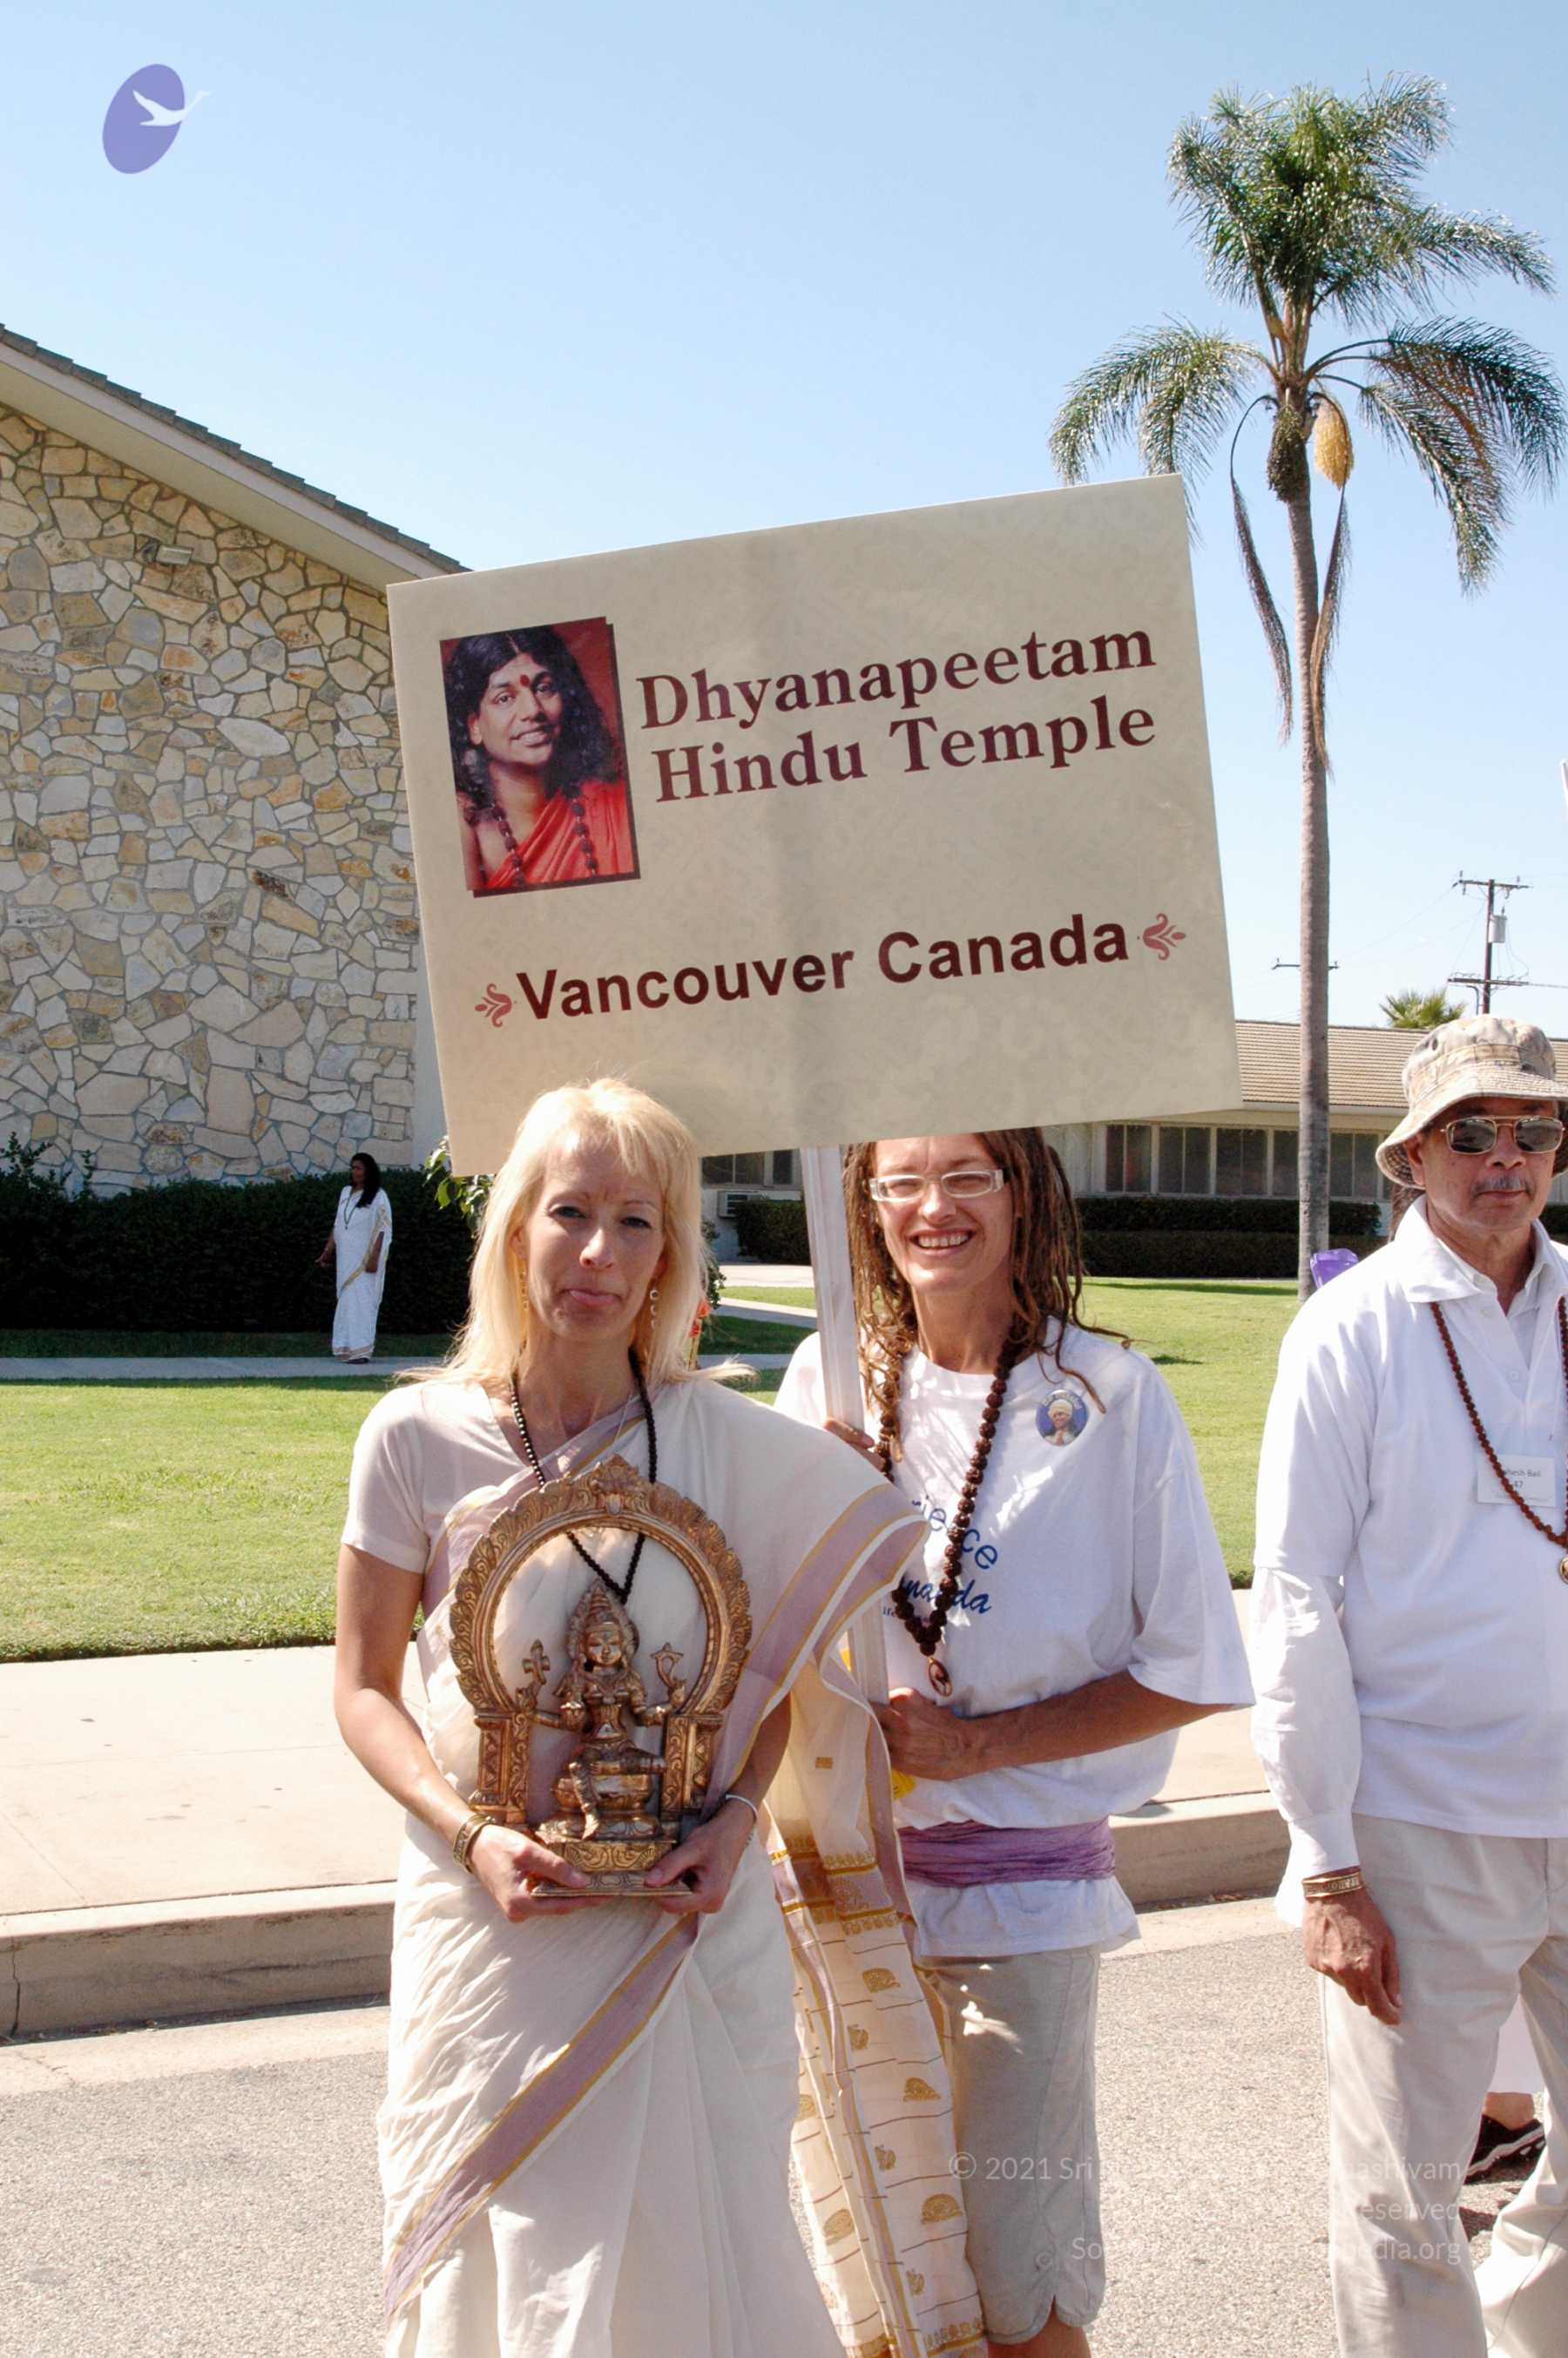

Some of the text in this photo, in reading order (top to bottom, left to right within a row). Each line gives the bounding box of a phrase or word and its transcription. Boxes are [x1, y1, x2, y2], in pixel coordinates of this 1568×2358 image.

[636, 631, 1157, 729] Dhyanapeetam
[651, 694, 1155, 802] Hindu Temple
[516, 913, 1129, 1019] Vancouver Canada
